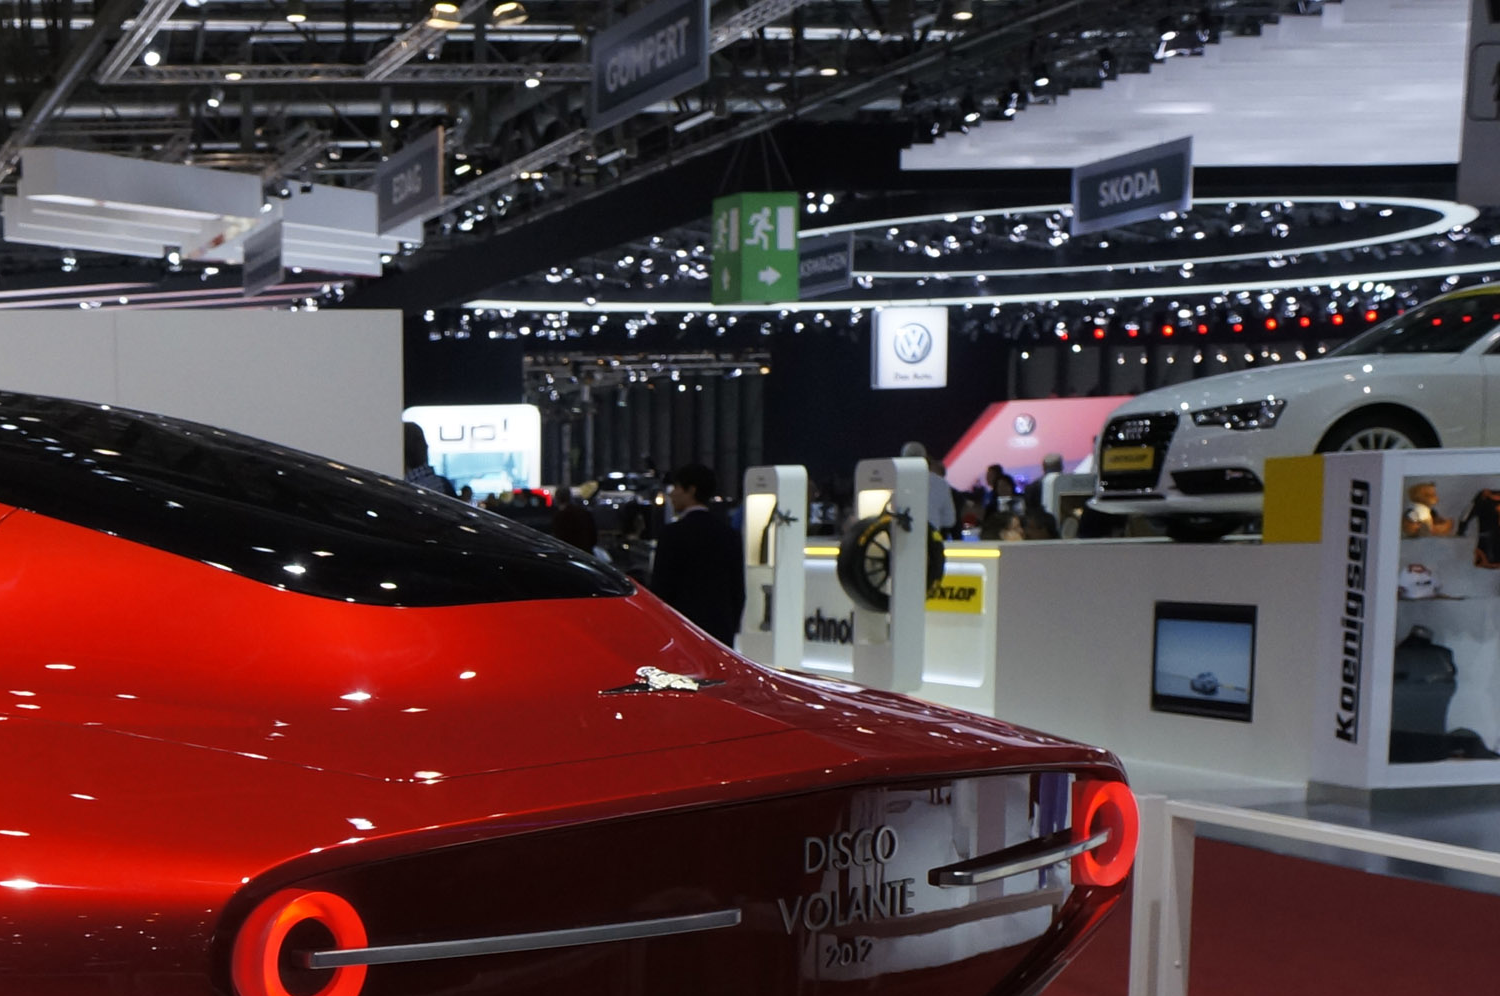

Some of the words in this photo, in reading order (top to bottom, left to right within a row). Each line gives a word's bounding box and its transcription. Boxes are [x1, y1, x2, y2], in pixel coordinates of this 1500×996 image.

[606, 17, 690, 93] GUMPERT
[1099, 168, 1160, 208] SKODA
[439, 418, 508, 449] up!
[804, 607, 854, 644] chnol
[1334, 479, 1370, 744] Koenigsegg
[803, 825, 899, 874] DISCO
[777, 877, 916, 936] VOLANTE
[825, 938, 873, 968] 2012
